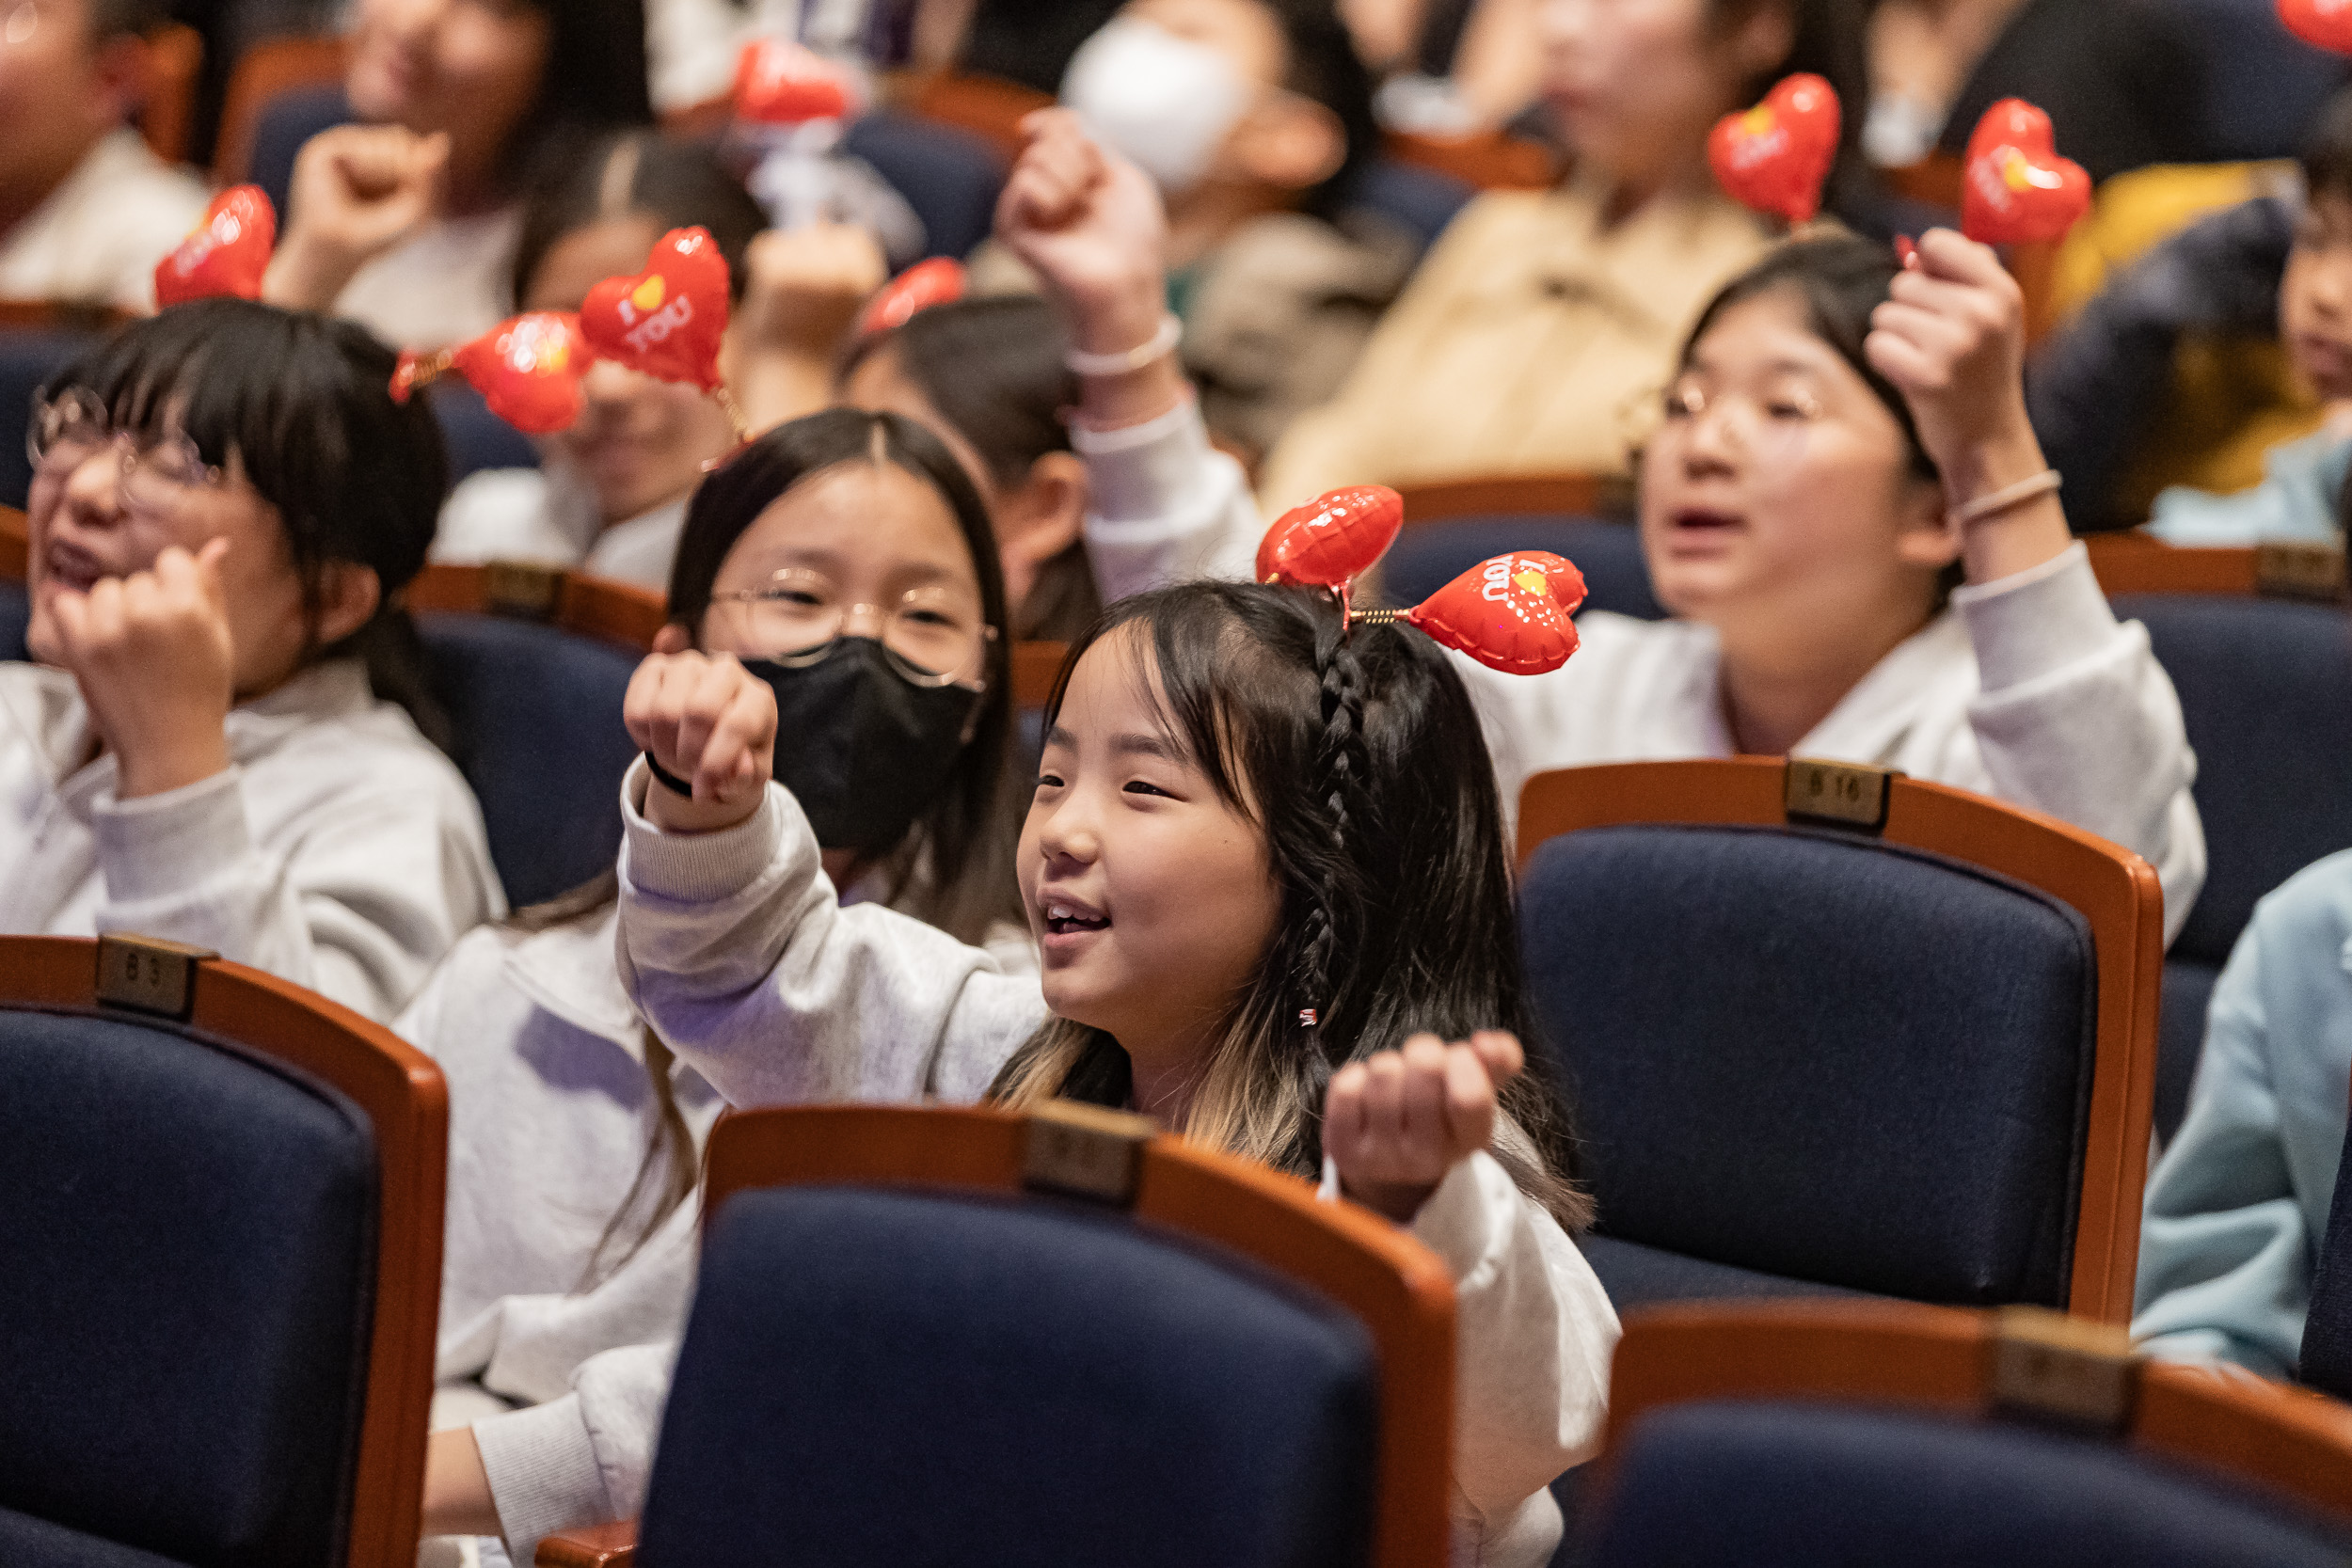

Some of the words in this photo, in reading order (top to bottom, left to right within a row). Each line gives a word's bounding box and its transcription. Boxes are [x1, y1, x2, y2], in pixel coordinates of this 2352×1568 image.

[617, 299, 636, 325] I
[626, 294, 692, 353] YOU
[1482, 555, 1513, 601] YOU
[1519, 559, 1546, 572] I
